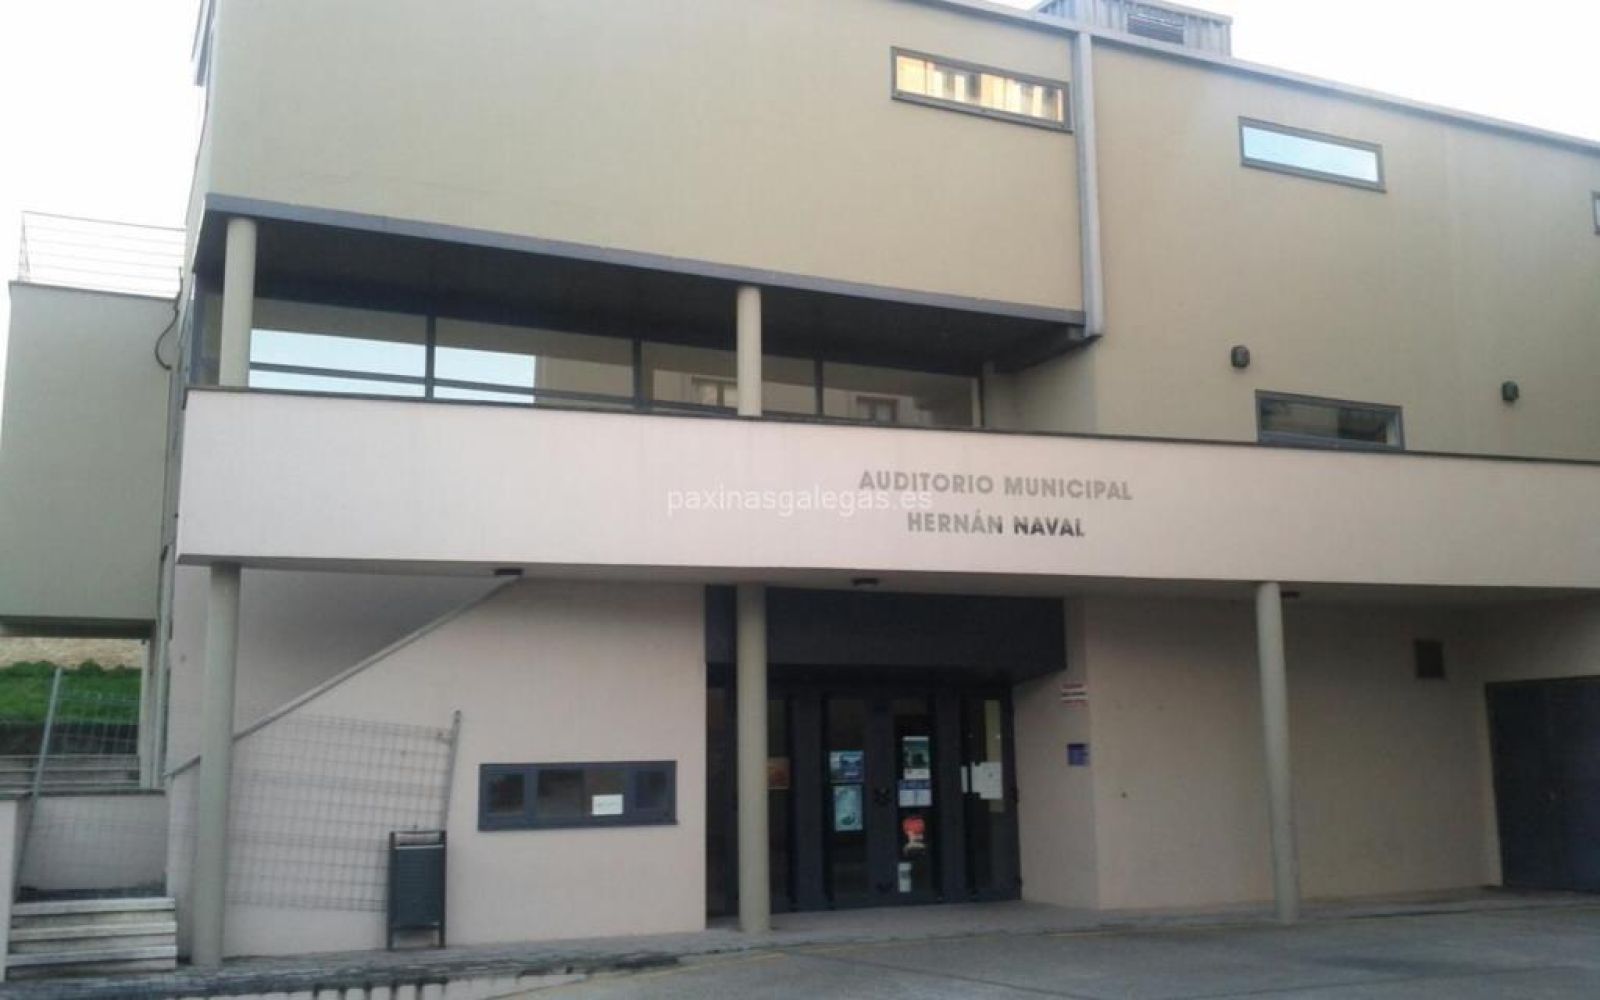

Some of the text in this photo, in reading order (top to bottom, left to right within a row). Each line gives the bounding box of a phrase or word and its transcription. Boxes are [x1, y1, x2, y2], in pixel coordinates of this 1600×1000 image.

[859, 469, 1133, 500] AUDITORIO MUNICIPAL
[907, 511, 1085, 538] HERNÁN NAVAL
